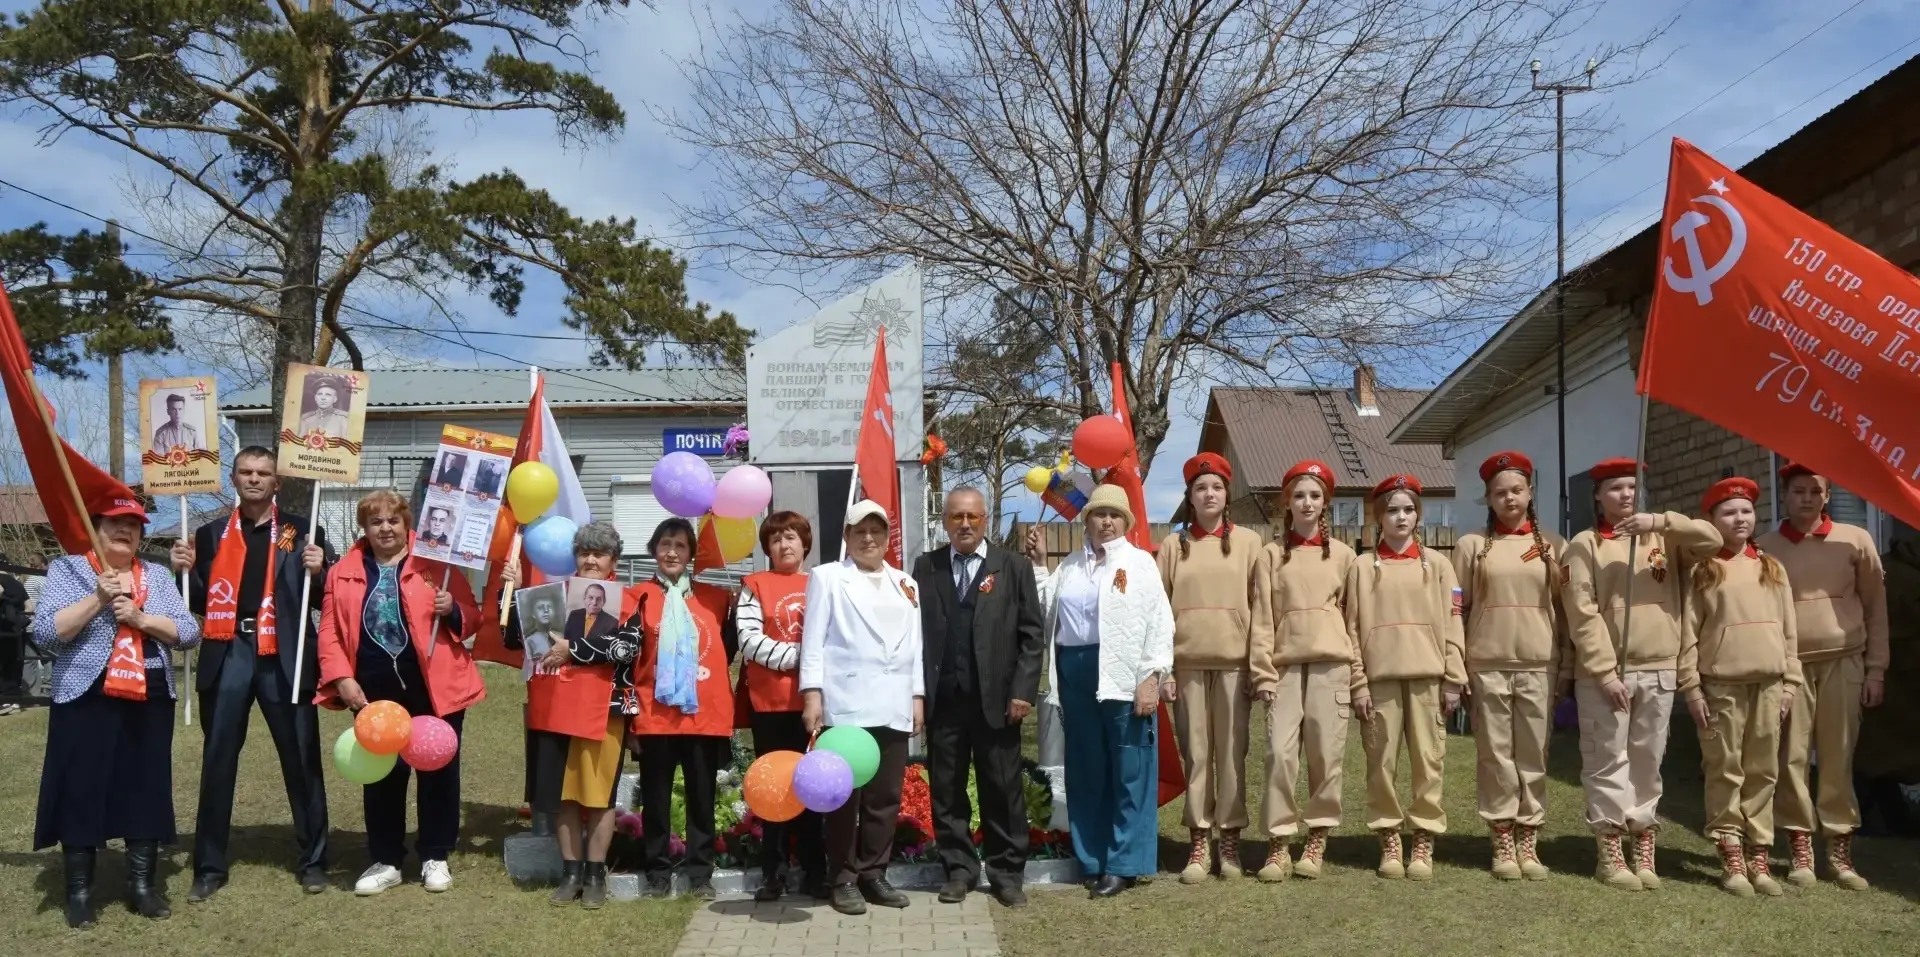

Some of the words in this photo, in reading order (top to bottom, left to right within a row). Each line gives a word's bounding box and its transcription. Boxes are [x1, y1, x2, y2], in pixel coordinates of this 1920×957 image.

[1784, 237, 1827, 273] 150
[834, 374, 845, 386] В
[1755, 351, 1810, 403] 79
[760, 386, 827, 399] ВЕЛИКОЙ
[774, 399, 866, 411] ОТЕЧЕСТВЕН
[675, 433, 722, 449] ПОЧТА
[777, 428, 862, 448] 1941-19
[297, 453, 341, 466] МОРДВИНОВ
[164, 467, 200, 478] ЛЯГОЦКИЙ
[289, 461, 306, 470] Яков
[307, 464, 348, 476] Васильевич
[207, 611, 236, 620] КПРФ
[260, 626, 276, 635] КП
